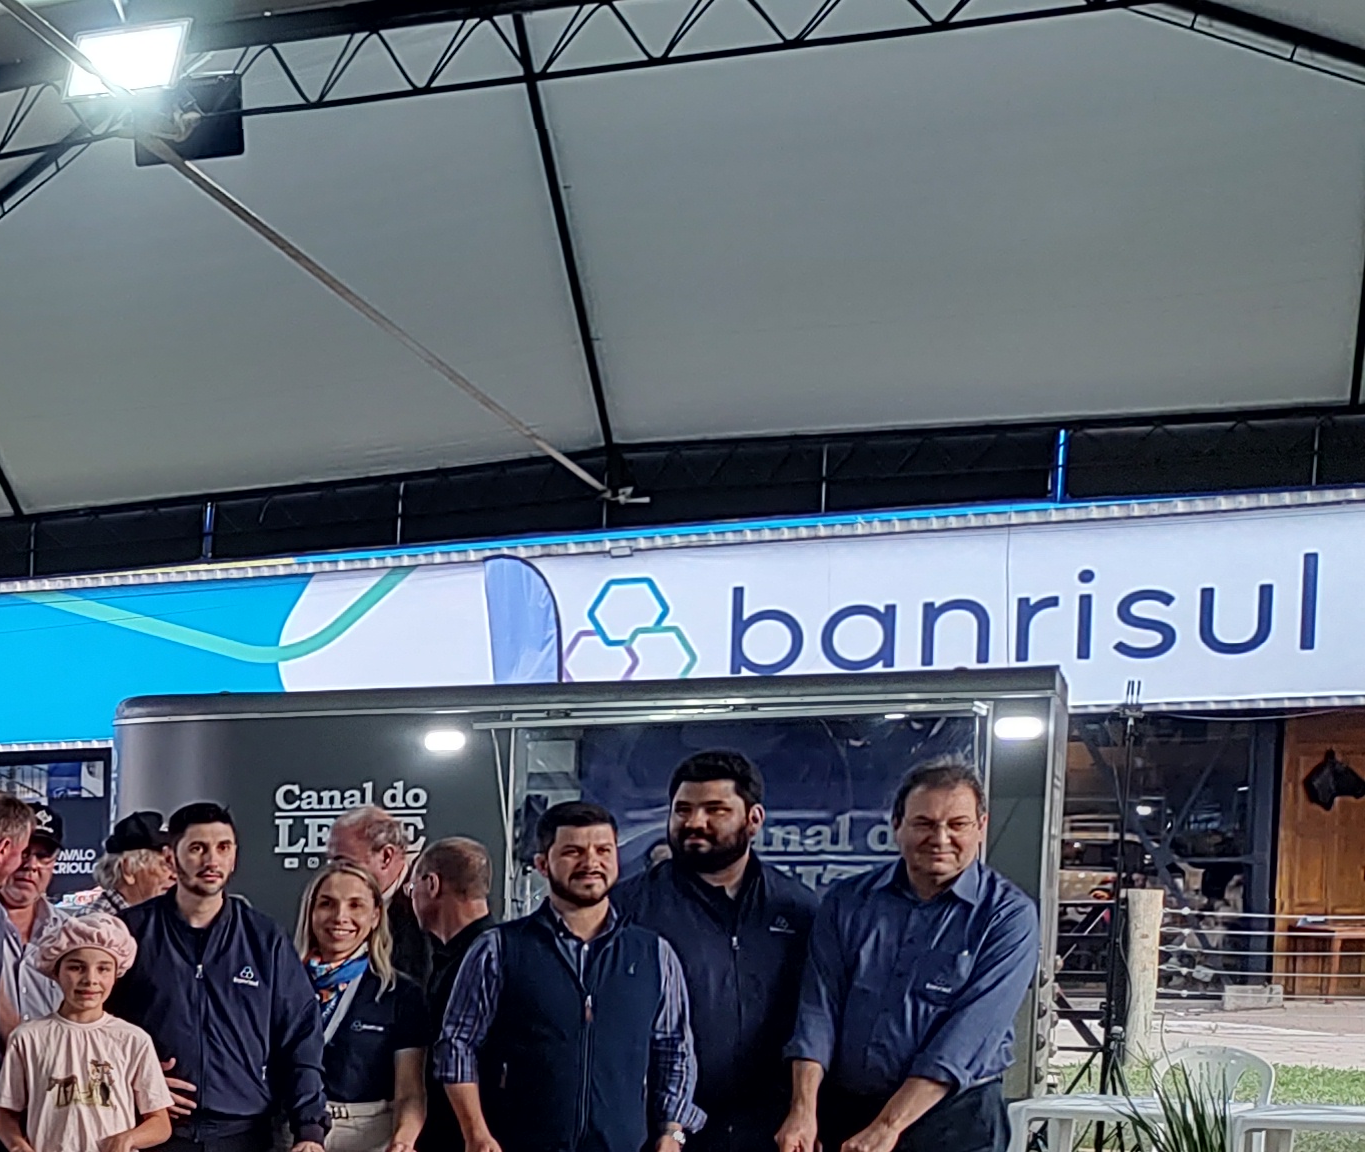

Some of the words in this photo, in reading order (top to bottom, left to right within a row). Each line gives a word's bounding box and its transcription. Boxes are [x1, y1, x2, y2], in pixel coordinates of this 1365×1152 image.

[730, 552, 1319, 675] banrisul
[275, 780, 374, 810] Canal
[382, 780, 428, 808] do
[274, 816, 427, 854] LEE
[58, 849, 97, 861] AVALO
